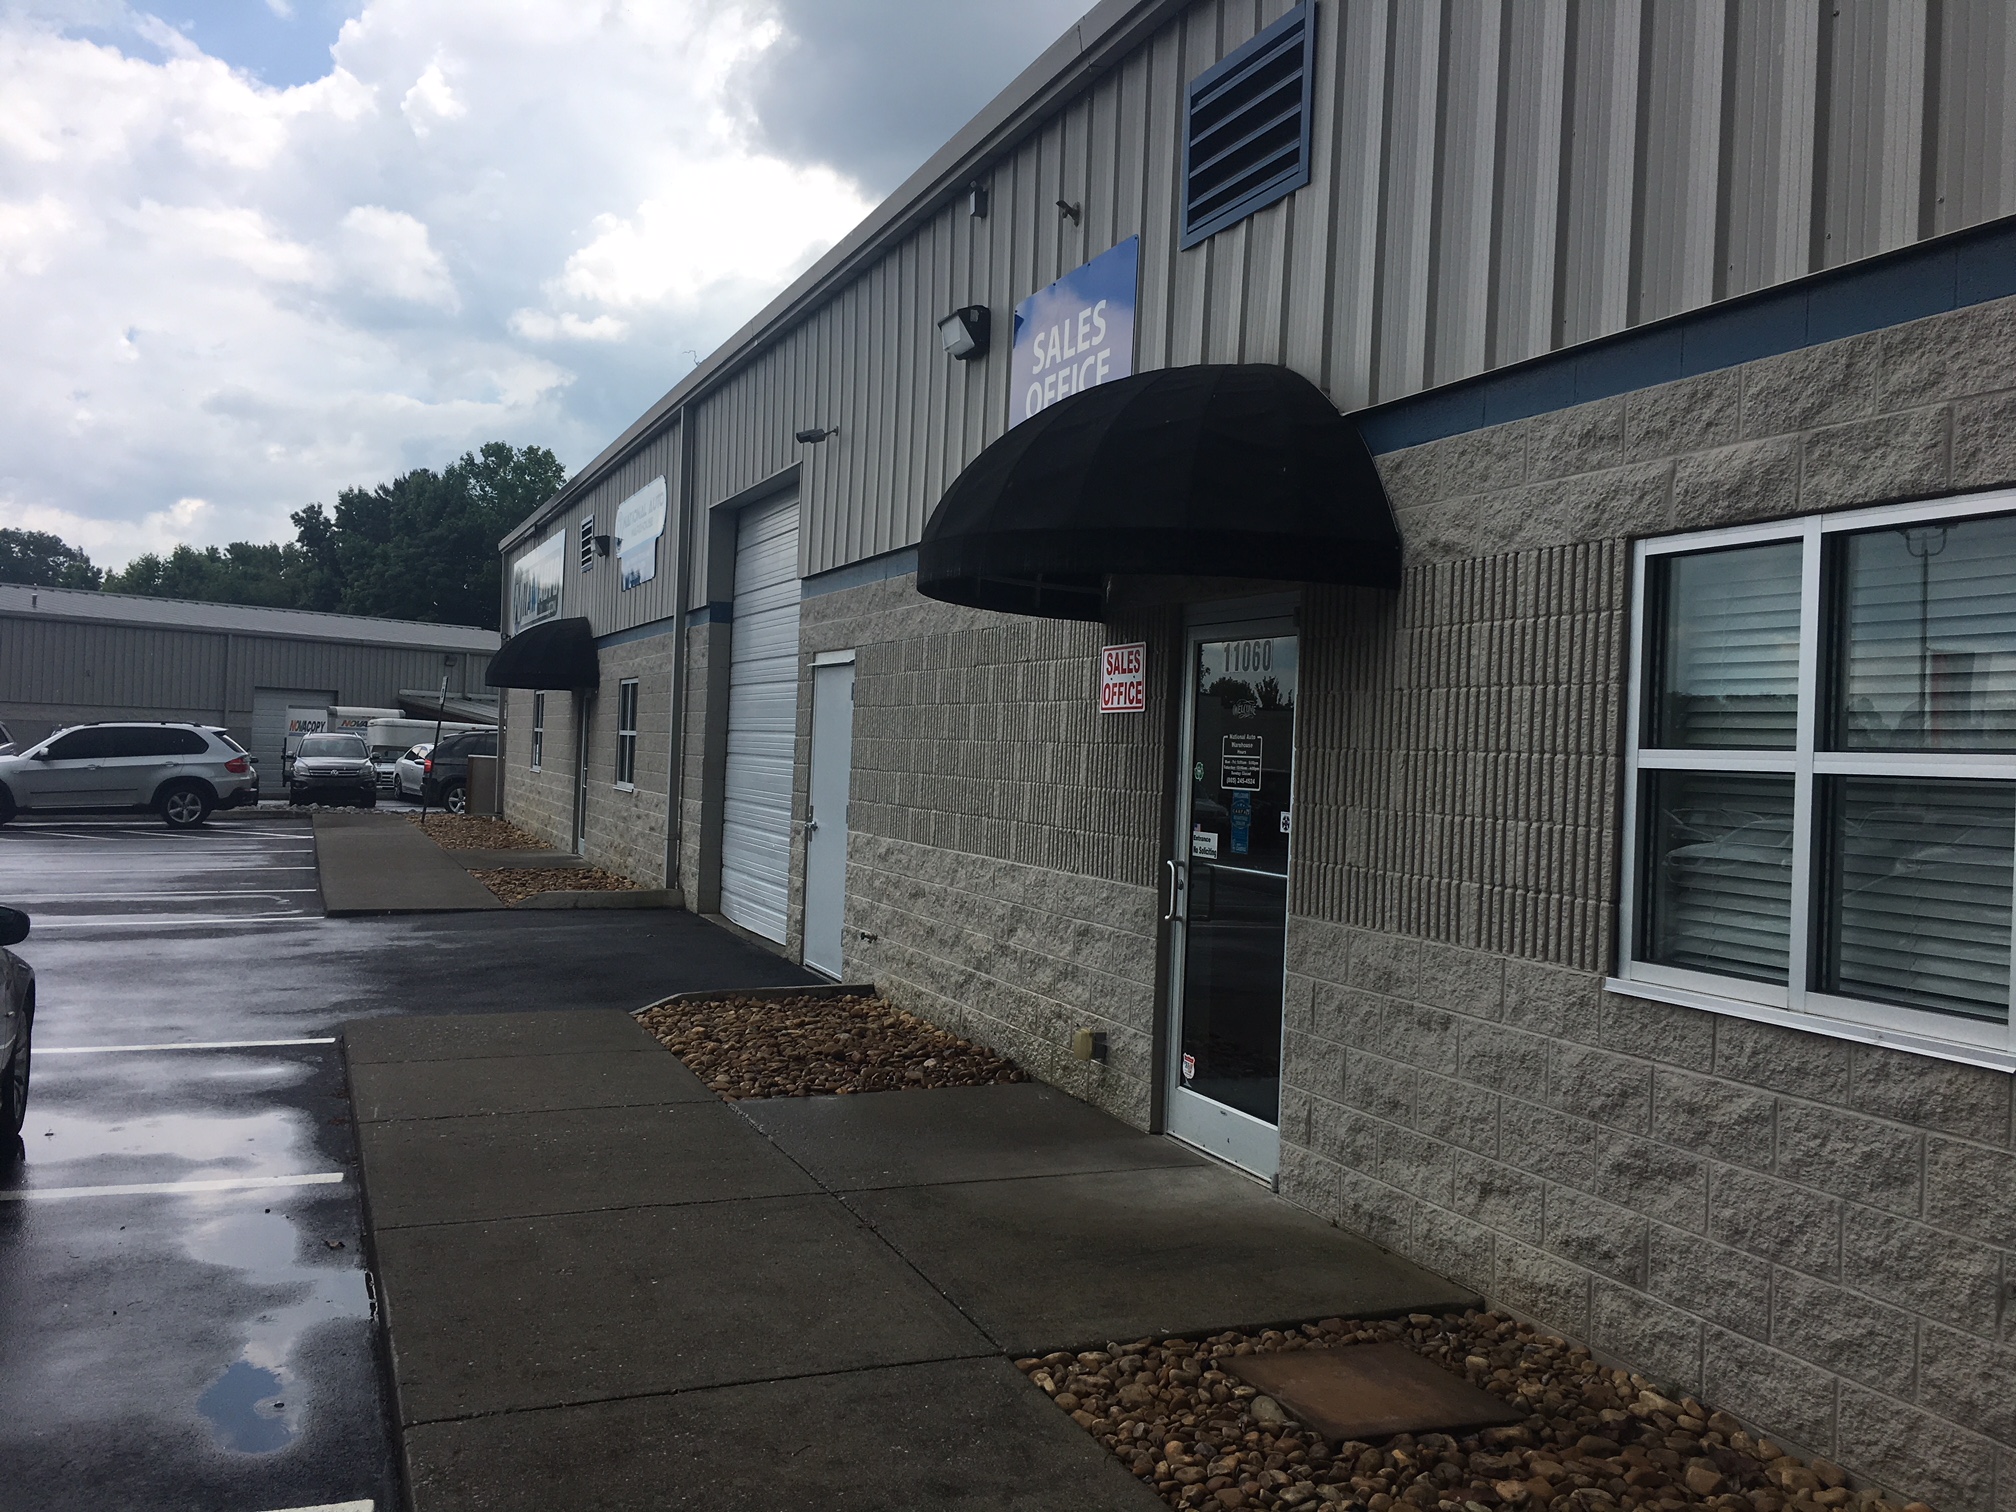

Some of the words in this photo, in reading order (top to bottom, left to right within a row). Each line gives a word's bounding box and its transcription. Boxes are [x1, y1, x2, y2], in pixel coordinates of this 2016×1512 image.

[1032, 299, 1107, 375] SALES
[1025, 348, 1110, 418] OFFICE
[648, 491, 664, 514] AUTO
[1106, 649, 1141, 676] SALES
[1224, 640, 1272, 672] 11060
[1103, 680, 1142, 706] OFFICE
[289, 719, 326, 733] NOVACOPY
[1193, 834, 1211, 843] Entrance
[1199, 846, 1217, 858] Soliciting
